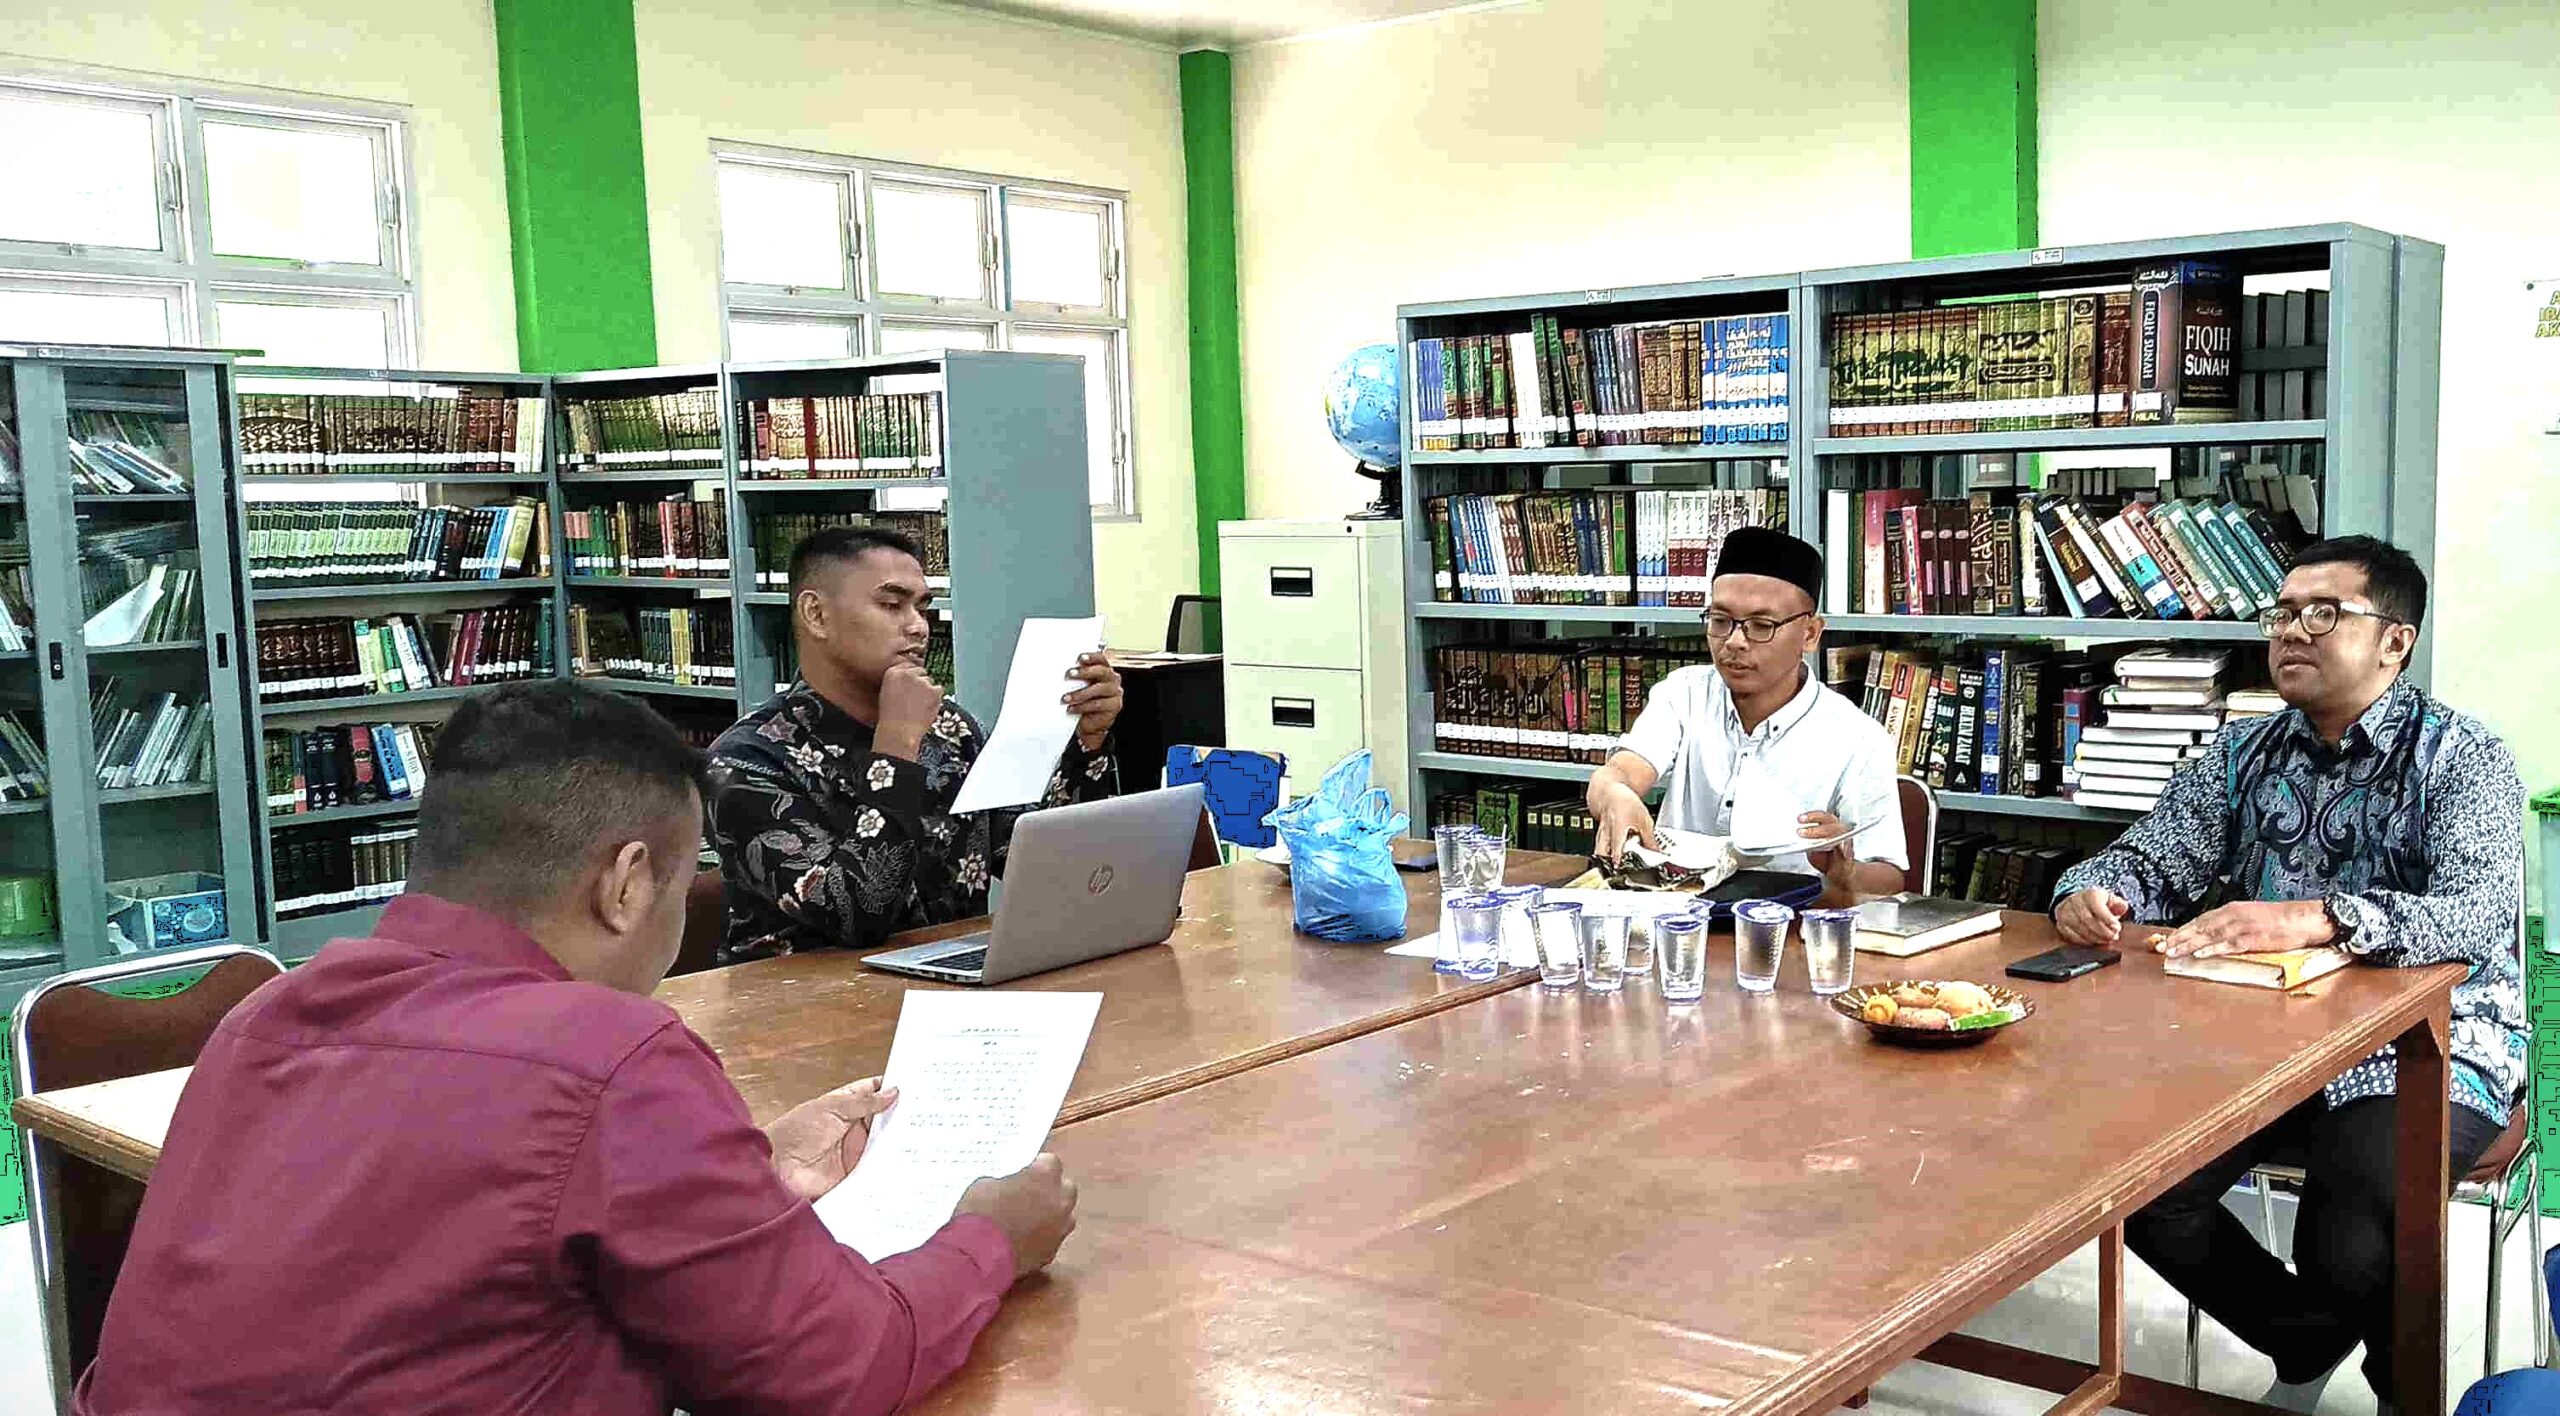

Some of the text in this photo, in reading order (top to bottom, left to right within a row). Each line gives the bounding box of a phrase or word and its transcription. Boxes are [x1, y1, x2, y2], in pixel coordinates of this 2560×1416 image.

[2143, 302, 2155, 379] FIQIH SUNAH
[2185, 325, 2231, 356] FIQIH
[2184, 353, 2230, 376] SUNAH
[1955, 736, 1973, 765] ZAKAT
